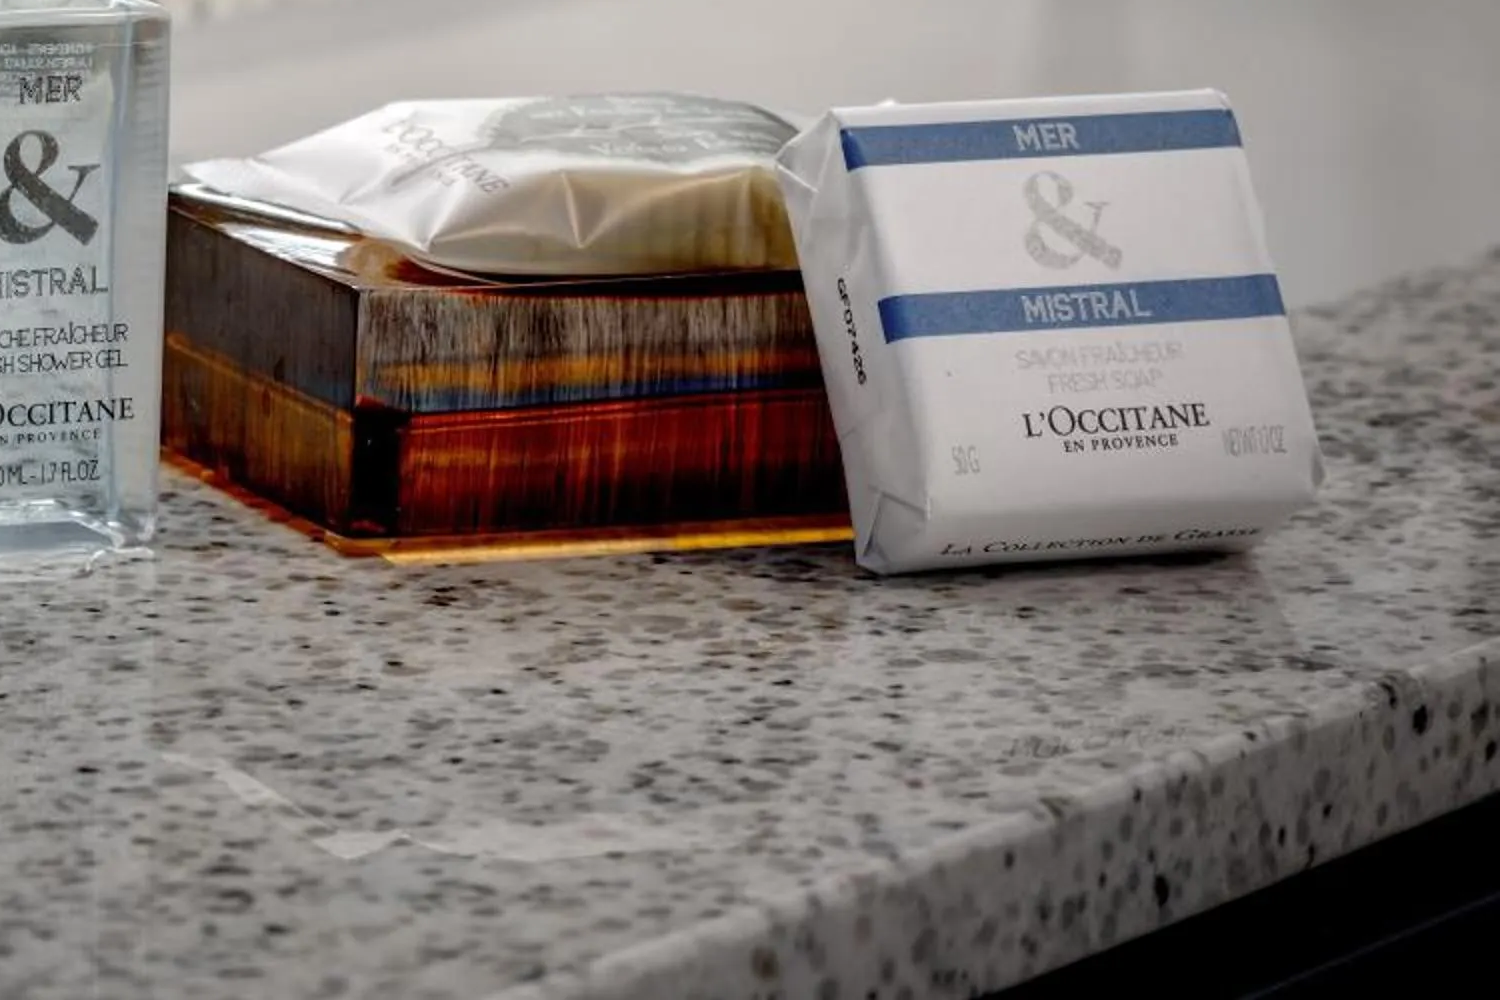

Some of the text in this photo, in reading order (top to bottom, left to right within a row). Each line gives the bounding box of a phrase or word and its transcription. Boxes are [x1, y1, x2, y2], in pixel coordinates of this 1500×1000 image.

[19, 75, 83, 104] MER
[1012, 122, 1081, 151] MER
[1022, 169, 1123, 272] &
[1020, 288, 1153, 323] MISTRAL
[18, 351, 93, 373] SHOWER
[95, 349, 129, 369] GEL
[1047, 367, 1164, 395] FRESH SOAP
[1022, 403, 1211, 438] L'OCCITANE
[17, 428, 100, 444] PROVENCE
[1064, 433, 1179, 453] EN PROVENCE
[8, 464, 28, 486] ML
